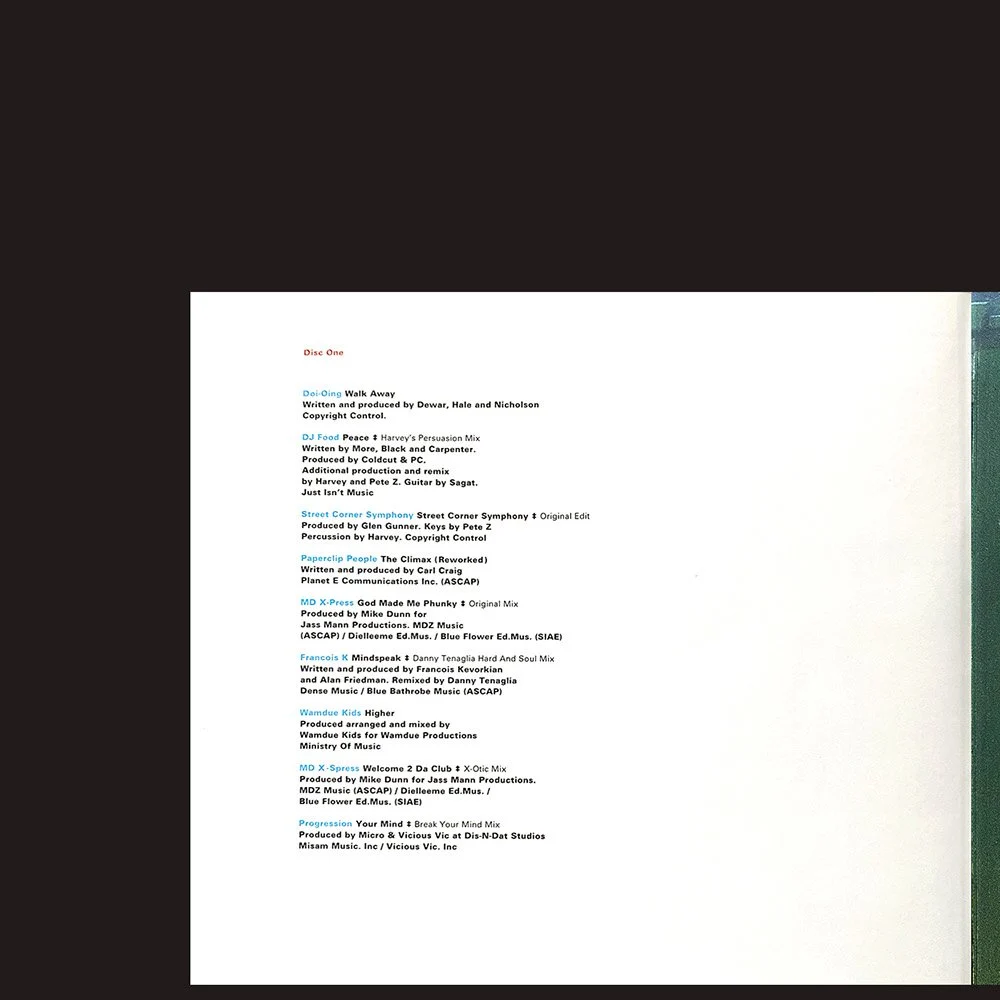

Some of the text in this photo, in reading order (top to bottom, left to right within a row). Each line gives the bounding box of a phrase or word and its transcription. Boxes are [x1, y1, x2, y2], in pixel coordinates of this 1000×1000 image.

[303, 390, 342, 398] Doi-Oing
[370, 390, 395, 399] Away
[358, 401, 400, 410] produced
[403, 401, 414, 410] by
[417, 401, 449, 409] Dewar,
[302, 466, 449, 476] Additional production and remix
[301, 488, 321, 496] Just
[301, 554, 488, 564] Paperclip People The Climax (Reworked)
[301, 576, 330, 584] Planet
[341, 577, 419, 585] Communications
[441, 578, 480, 586] (ASCAP)
[301, 598, 316, 606] MD
[320, 598, 354, 606] X-Press
[357, 599, 376, 607] God
[379, 599, 404, 607] Made
[407, 599, 421, 607] Me
[423, 600, 457, 609] Phunky
[469, 600, 501, 609] Original
[351, 654, 401, 663] Mindspeak
[413, 654, 439, 663] Danny
[441, 654, 476, 664] Tenaglia
[518, 655, 537, 663] Soul
[299, 819, 352, 828] Progression
[356, 820, 378, 828] Your
[380, 820, 403, 828] Mind
[414, 820, 437, 828] Break
[299, 830, 342, 838] Produced
[344, 831, 356, 840] by
[358, 831, 385, 839] Micro
[387, 831, 395, 839] &
[398, 831, 432, 839] Vicious
[464, 832, 508, 840] Dis-N-Dat
[511, 832, 545, 840] Studios
